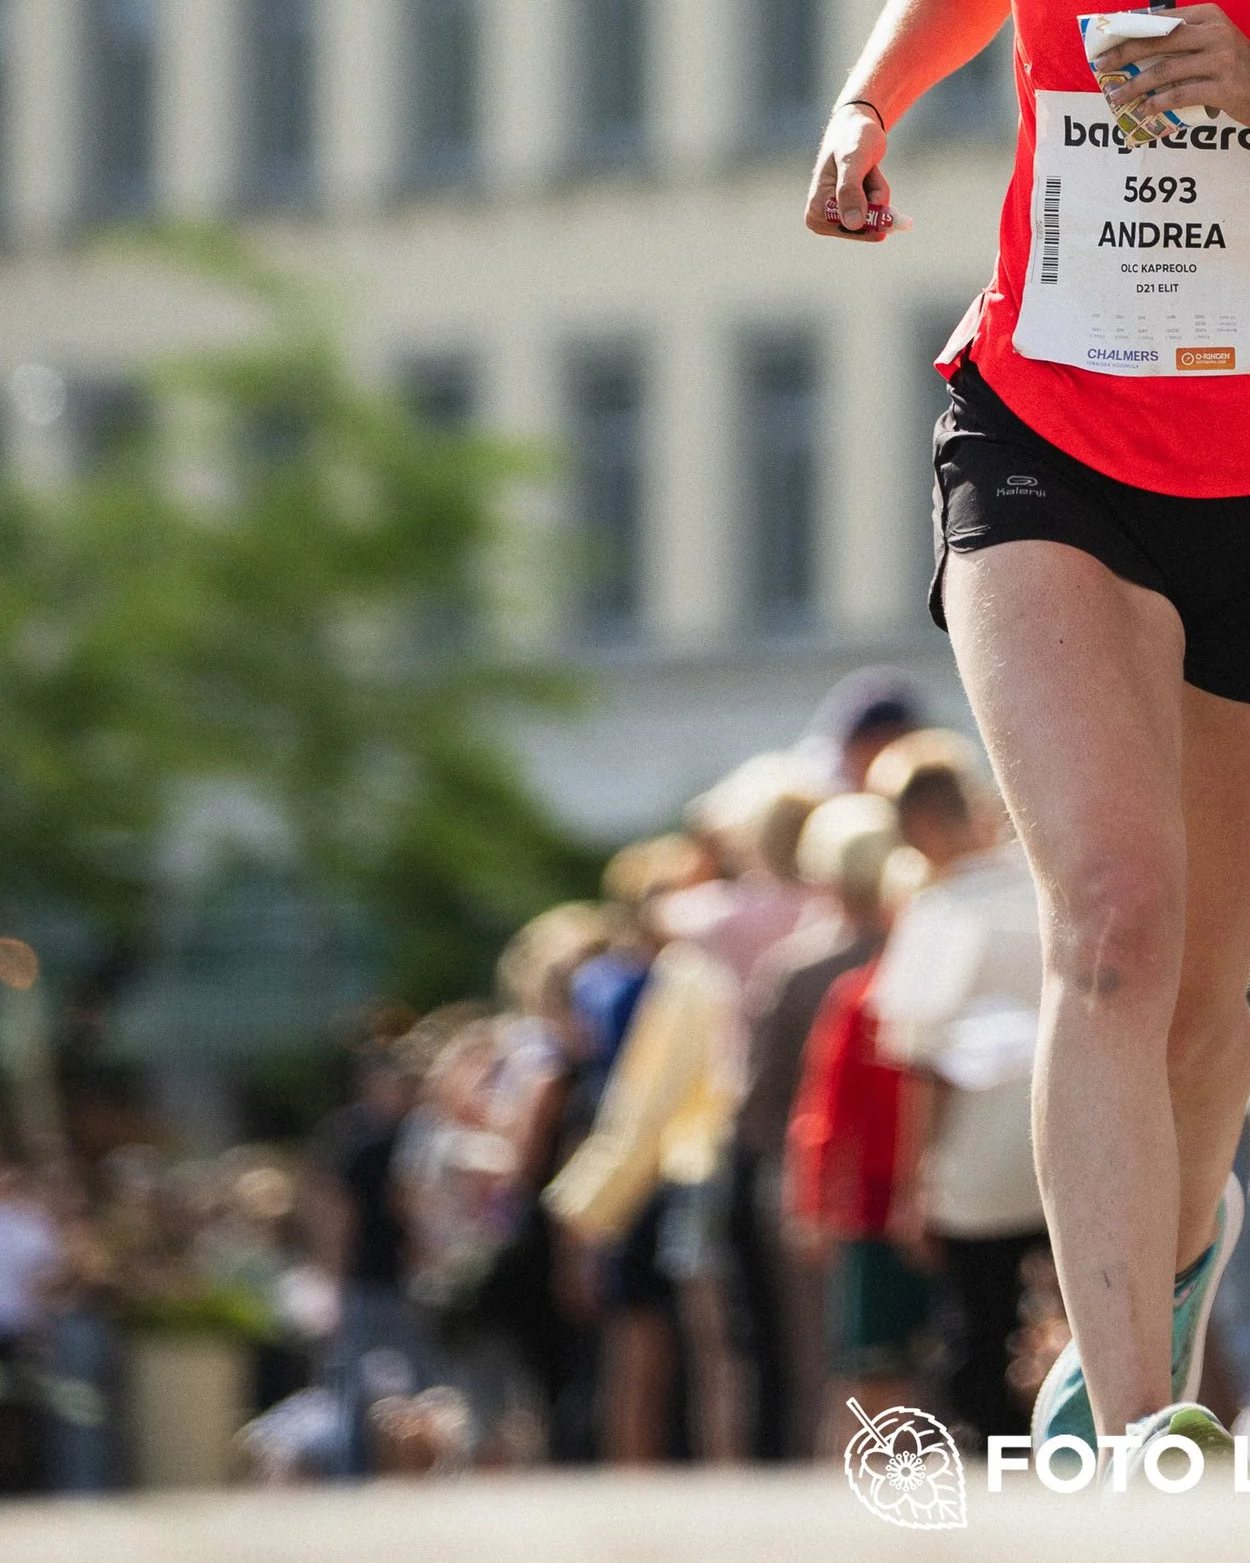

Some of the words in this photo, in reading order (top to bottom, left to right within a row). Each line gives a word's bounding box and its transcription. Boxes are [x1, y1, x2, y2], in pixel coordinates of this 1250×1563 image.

[1123, 176, 1198, 204] 5693
[1098, 221, 1227, 249] ANDREA
[1120, 263, 1139, 273] OLC
[1141, 263, 1197, 273] KAPREOLO
[1136, 284, 1155, 293] D21
[1158, 283, 1179, 293] ELIT
[1087, 348, 1159, 362] CHALMERS
